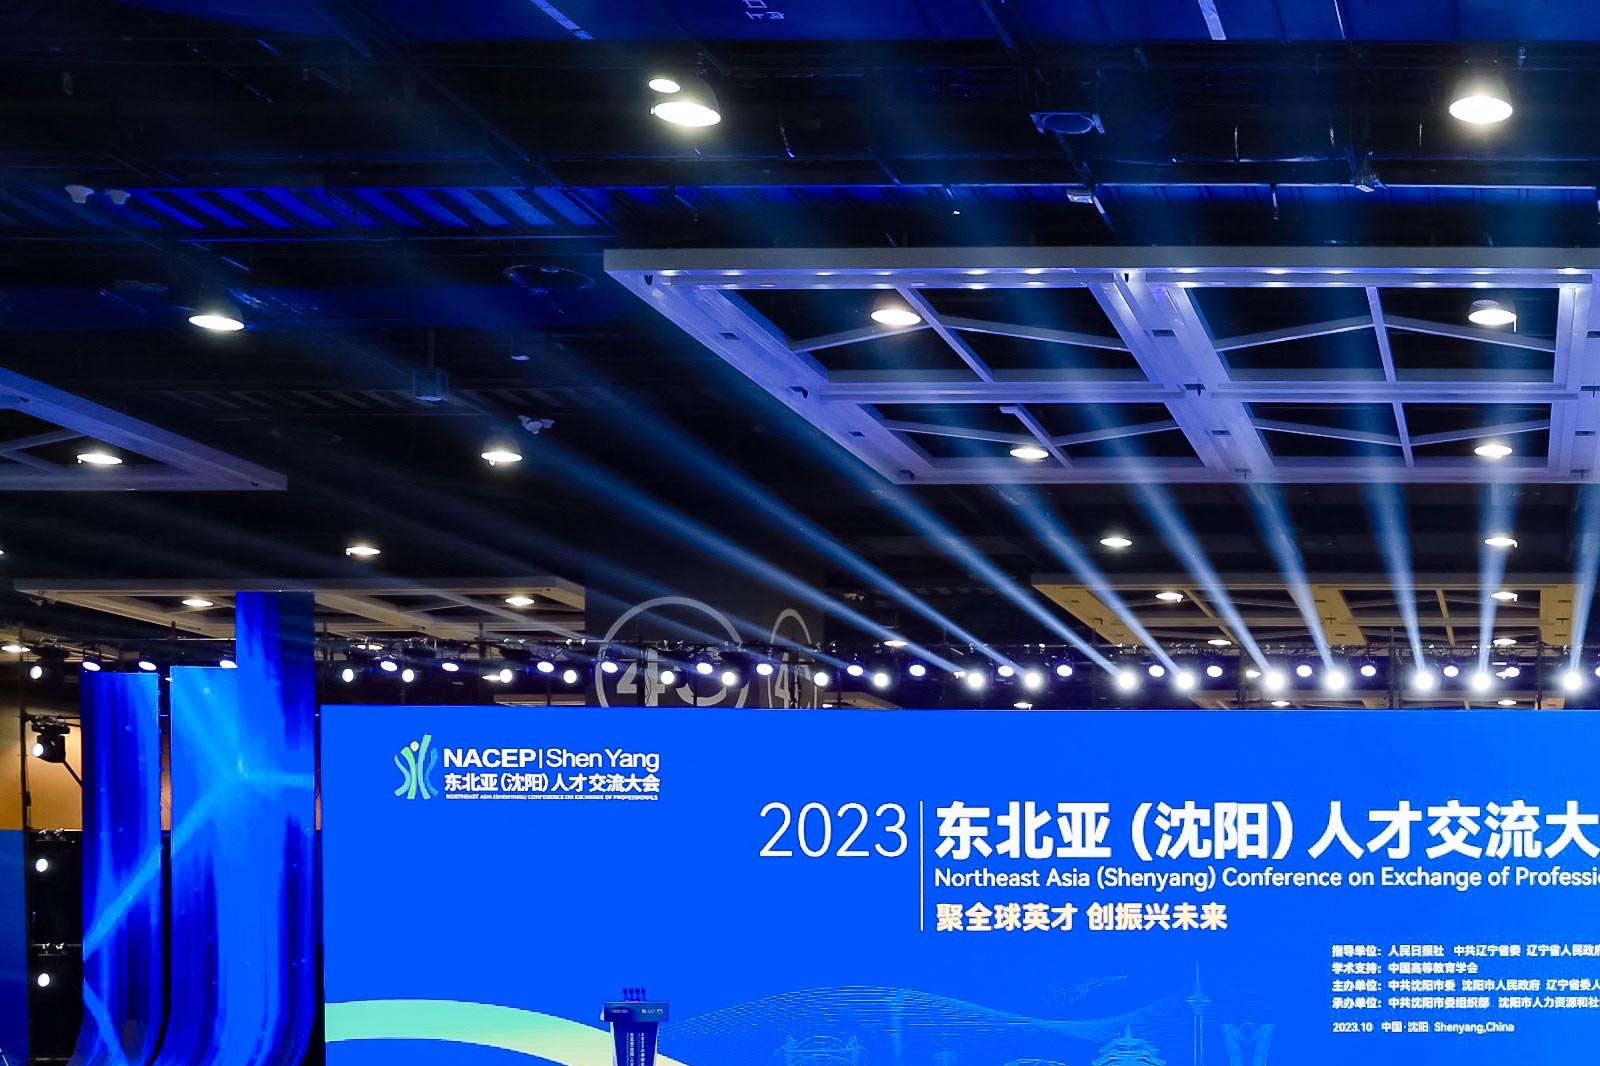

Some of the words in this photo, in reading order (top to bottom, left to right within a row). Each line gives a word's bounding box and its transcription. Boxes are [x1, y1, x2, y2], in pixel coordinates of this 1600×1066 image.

[443, 748, 537, 768] NACEP
[545, 748, 603, 768] Shen
[604, 748, 660, 772] Yang
[444, 772, 660, 793] 东北亚（沈阳）人才交流大会
[759, 801, 908, 858] 2023
[934, 867, 1041, 887] Northeast
[1045, 867, 1091, 887] Asia
[1096, 866, 1217, 893] (Shenyang)
[1221, 866, 1343, 887] Conference
[1348, 871, 1375, 887] on
[1381, 866, 1482, 892] Exchange
[1487, 865, 1511, 887] of
[936, 901, 1079, 932] 聚全球英才
[1085, 901, 1228, 931] 创振兴未来
[1388, 944, 1445, 957] 人民日报社
[1453, 944, 1521, 957] 中共辽宁省委
[1388, 961, 1478, 975] 中国高等教育学会
[1388, 978, 1456, 992] 中共沈阳市委
[1461, 978, 1541, 992] 沈阳市人民政府
[1388, 996, 1490, 1009] 中共沈阳市委组织部
[1332, 1022, 1373, 1033] 2023.10
